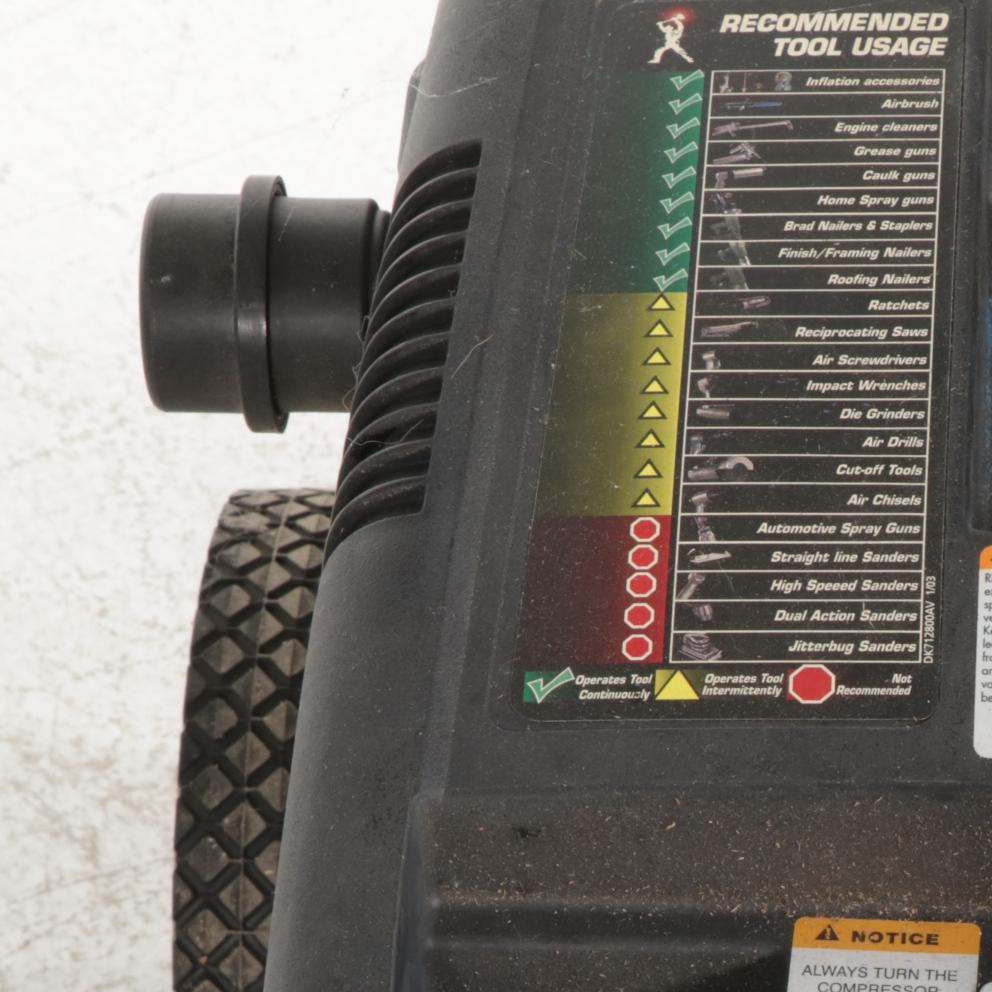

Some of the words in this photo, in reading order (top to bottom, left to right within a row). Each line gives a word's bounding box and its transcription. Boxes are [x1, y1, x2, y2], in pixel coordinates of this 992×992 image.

[720, 13, 949, 33] RECOMMENDED
[774, 38, 841, 56] TOOL
[852, 37, 948, 56] USAGE
[806, 77, 860, 86] Inflation
[864, 76, 940, 86] accessories
[881, 99, 939, 108] Airbrush
[835, 123, 878, 133] Engine
[882, 122, 937, 132] cleaners
[854, 147, 899, 156] Grease
[904, 148, 936, 158] guns
[863, 171, 899, 181] Caulk
[903, 172, 935, 182] guns
[817, 195, 855, 205] Home
[859, 195, 898, 207] Spray
[902, 197, 934, 207] guns
[784, 221, 813, 231] Brad
[818, 221, 862, 231] Nailers
[867, 221, 876, 231] &
[880, 221, 933, 232] Staplers
[778, 248, 879, 259] Finish/Framing
[883, 248, 932, 257] Nailers
[828, 275, 877, 286] Roofing
[882, 274, 930, 284] Nailers
[868, 301, 929, 310] Ratchets
[795, 327, 888, 339] Reciprocating
[892, 327, 928, 337] Saws
[813, 355, 834, 365] Air
[838, 355, 927, 365] Screwdrivers
[806, 381, 854, 392] Impact
[858, 380, 926, 391] Wrenches
[840, 409, 862, 419] Die
[866, 409, 925, 419] Grinders
[862, 437, 884, 447] Air
[887, 437, 924, 447] Drills
[836, 465, 884, 475] Cut-off
[889, 465, 923, 475] Tools
[847, 495, 869, 505] Air
[872, 495, 922, 505] Chisels
[757, 524, 836, 534] Automotive
[841, 524, 881, 536] Spray
[885, 524, 920, 533] Guns
[771, 551, 830, 565] Straight
[834, 552, 858, 563] line
[862, 551, 919, 563] Sanders
[770, 580, 802, 594] High
[861, 580, 918, 591] Sanders
[926, 576, 936, 594] 1/03
[774, 610, 807, 622] Dual
[810, 610, 855, 622] Action
[860, 610, 918, 622] Sanders
[788, 640, 855, 654] Jitterbug
[858, 640, 917, 652] Sanders
[575, 675, 625, 686] Operates
[631, 674, 652, 684] Tool
[705, 674, 756, 684] Operates
[761, 673, 783, 683] Tool
[892, 674, 912, 683] Not
[579, 690, 650, 701] Continuously
[702, 686, 782, 697] Intermittently
[836, 686, 911, 695] Recommended
[852, 931, 939, 945] NOTICE
[802, 965, 868, 978] ALWAYS
[874, 967, 920, 980] TURN
[925, 969, 958, 981] THE
